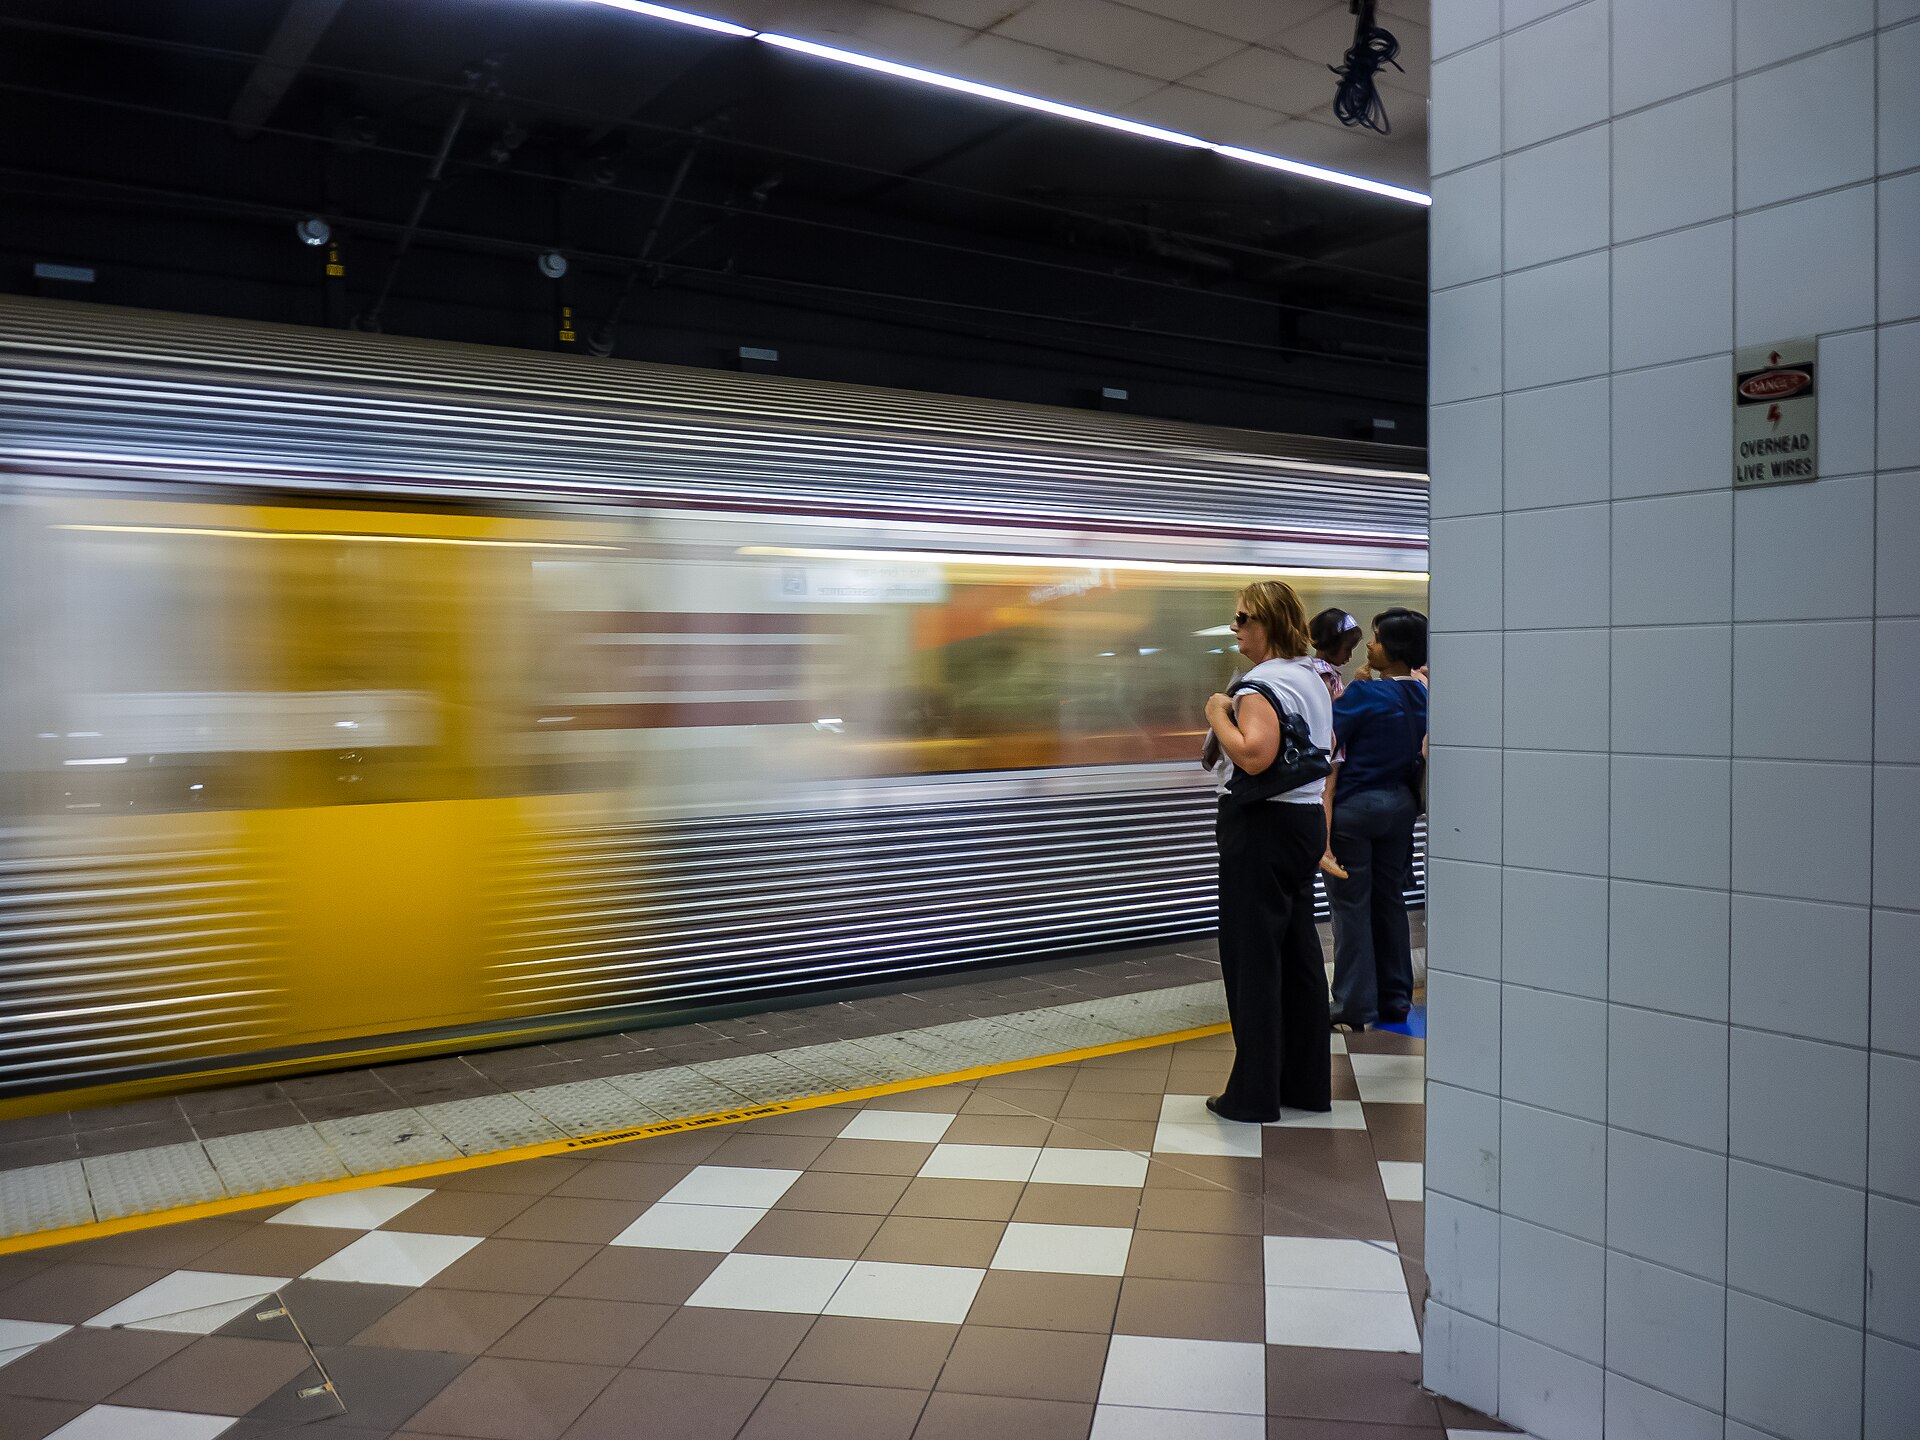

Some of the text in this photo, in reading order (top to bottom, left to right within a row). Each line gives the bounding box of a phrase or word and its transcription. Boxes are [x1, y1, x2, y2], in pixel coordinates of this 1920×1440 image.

[1740, 434, 1809, 458] OVERHEAD
[1737, 458, 1812, 481] LIVE WIRES
[580, 1131, 641, 1144] BEHIND
[645, 1124, 682, 1133] THIS
[685, 1117, 721, 1127] LINE
